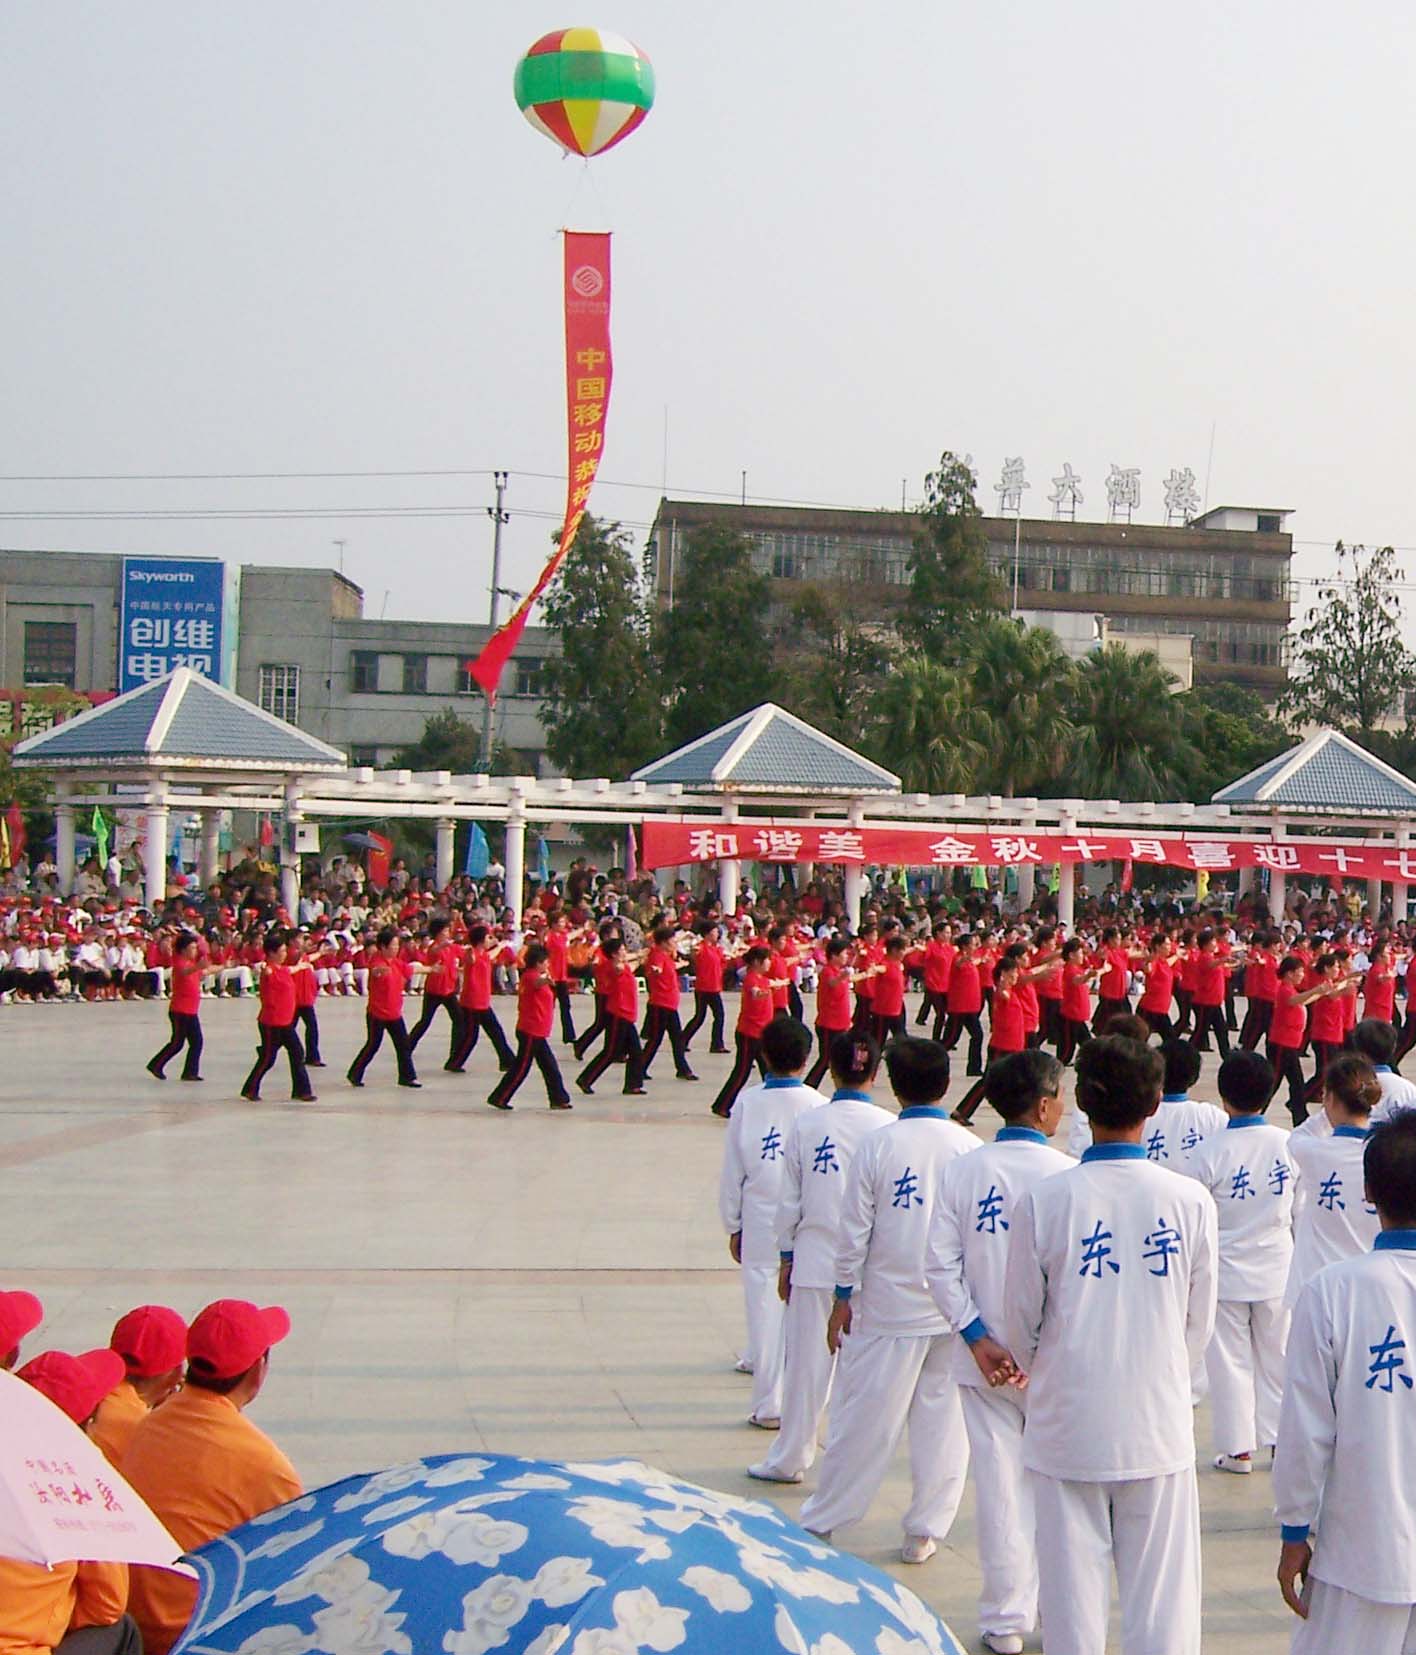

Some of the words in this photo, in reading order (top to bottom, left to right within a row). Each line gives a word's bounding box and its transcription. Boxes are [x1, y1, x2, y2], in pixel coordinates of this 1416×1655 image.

[128, 570, 195, 584] Skyworth
[130, 618, 215, 649] 创维
[690, 829, 867, 861] 和谐美
[761, 1126, 785, 1161] 东
[812, 1135, 840, 1175] 东
[1147, 1127, 1204, 1160] 东宇
[892, 1166, 924, 1210] 东
[1231, 1159, 1290, 1200] 东宇
[975, 1185, 1010, 1234] 东
[1078, 1217, 1182, 1279] 东宇
